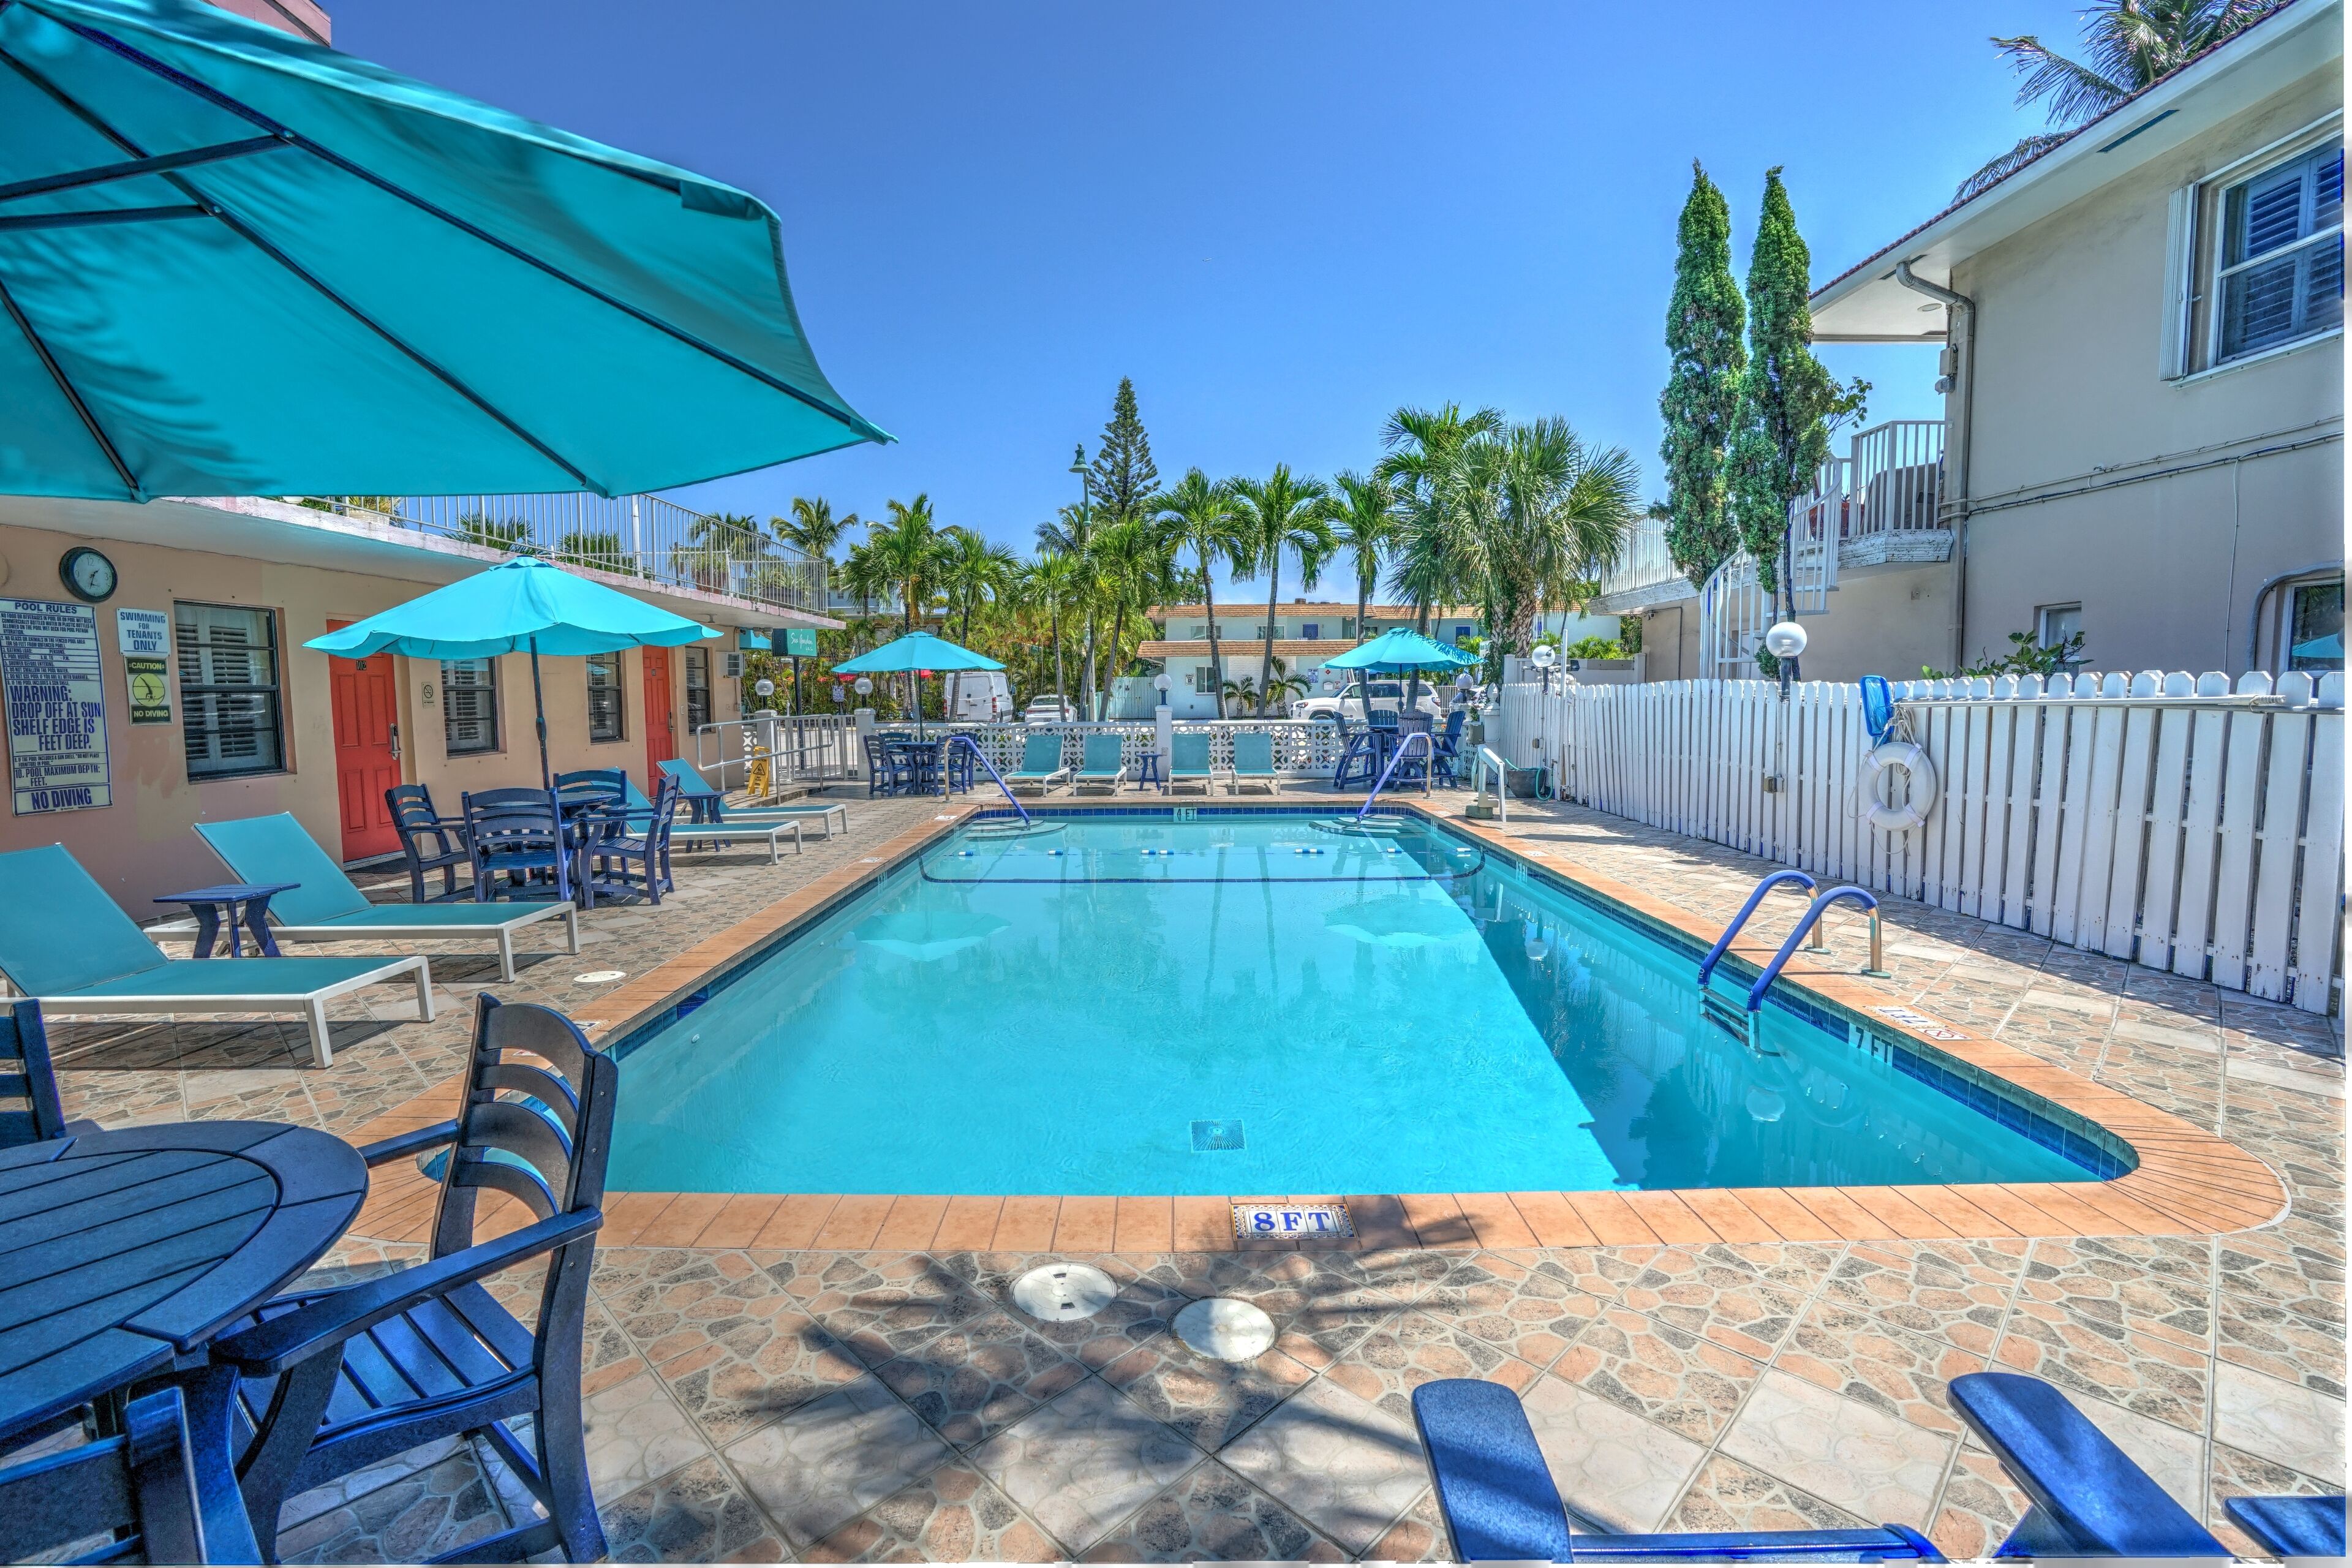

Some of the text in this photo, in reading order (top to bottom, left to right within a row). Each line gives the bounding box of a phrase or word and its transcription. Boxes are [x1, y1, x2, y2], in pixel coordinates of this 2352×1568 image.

[86, 557, 94, 566] 12
[104, 572, 109, 581] 3
[15, 602, 77, 614] POOL RULES
[120, 611, 166, 624] SWIMMING
[127, 630, 162, 639] TENANTS
[133, 640, 157, 650] ONLY
[356, 660, 367, 671] 102
[10, 685, 72, 702] WARNING:
[12, 701, 101, 718] DROP OFF AT SUN
[13, 718, 95, 736] SHELF EDGE IS
[39, 734, 91, 751] FEET DEEP.
[15, 764, 100, 778] 10. POOL MAXIMUM DEPTH:
[31, 777, 47, 786] FEET.
[31, 787, 92, 810] NO DIVING
[1856, 1026, 1893, 1064] 7 FT
[1254, 1212, 1330, 1231] 8FT
